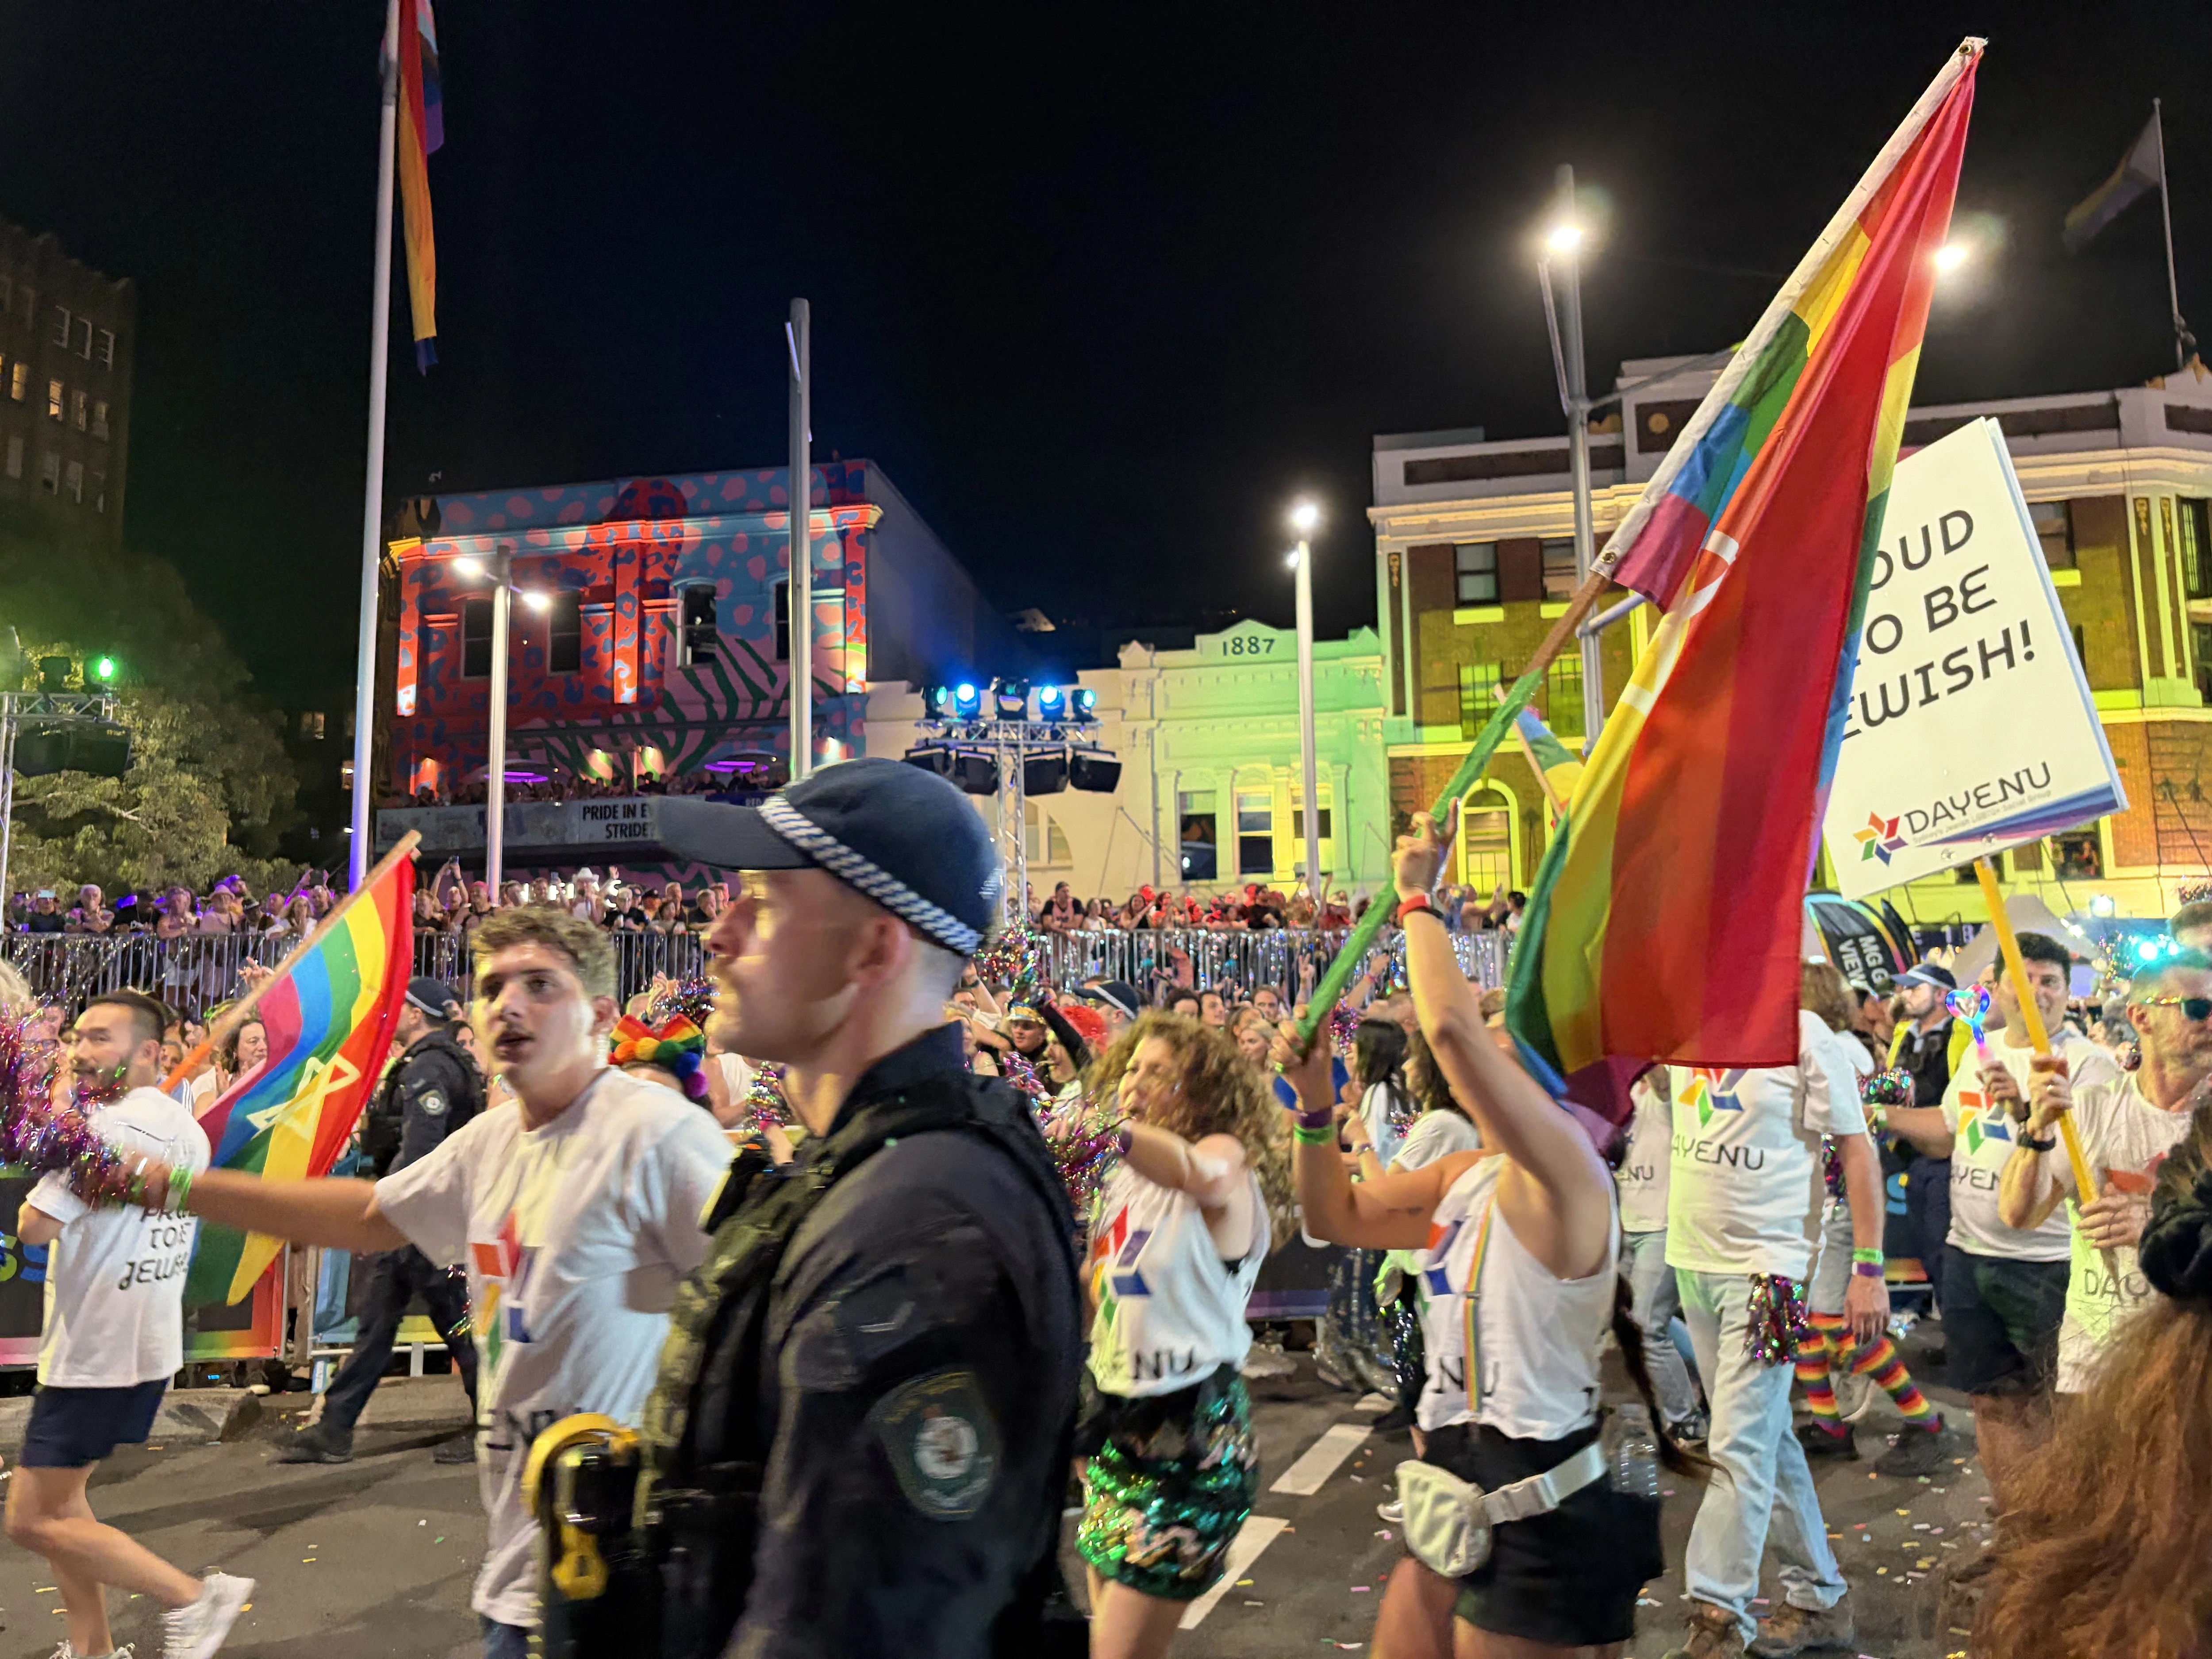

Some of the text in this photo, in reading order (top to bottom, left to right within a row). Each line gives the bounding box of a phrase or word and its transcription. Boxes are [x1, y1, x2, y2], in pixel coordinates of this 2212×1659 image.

[1924, 564, 1998, 633] BE
[1223, 636, 1275, 656] 1887
[583, 804, 618, 821] PRIDE
[622, 803, 636, 818] IN
[1904, 760, 2051, 835] DAYENU
[1859, 935, 1883, 968] MG
